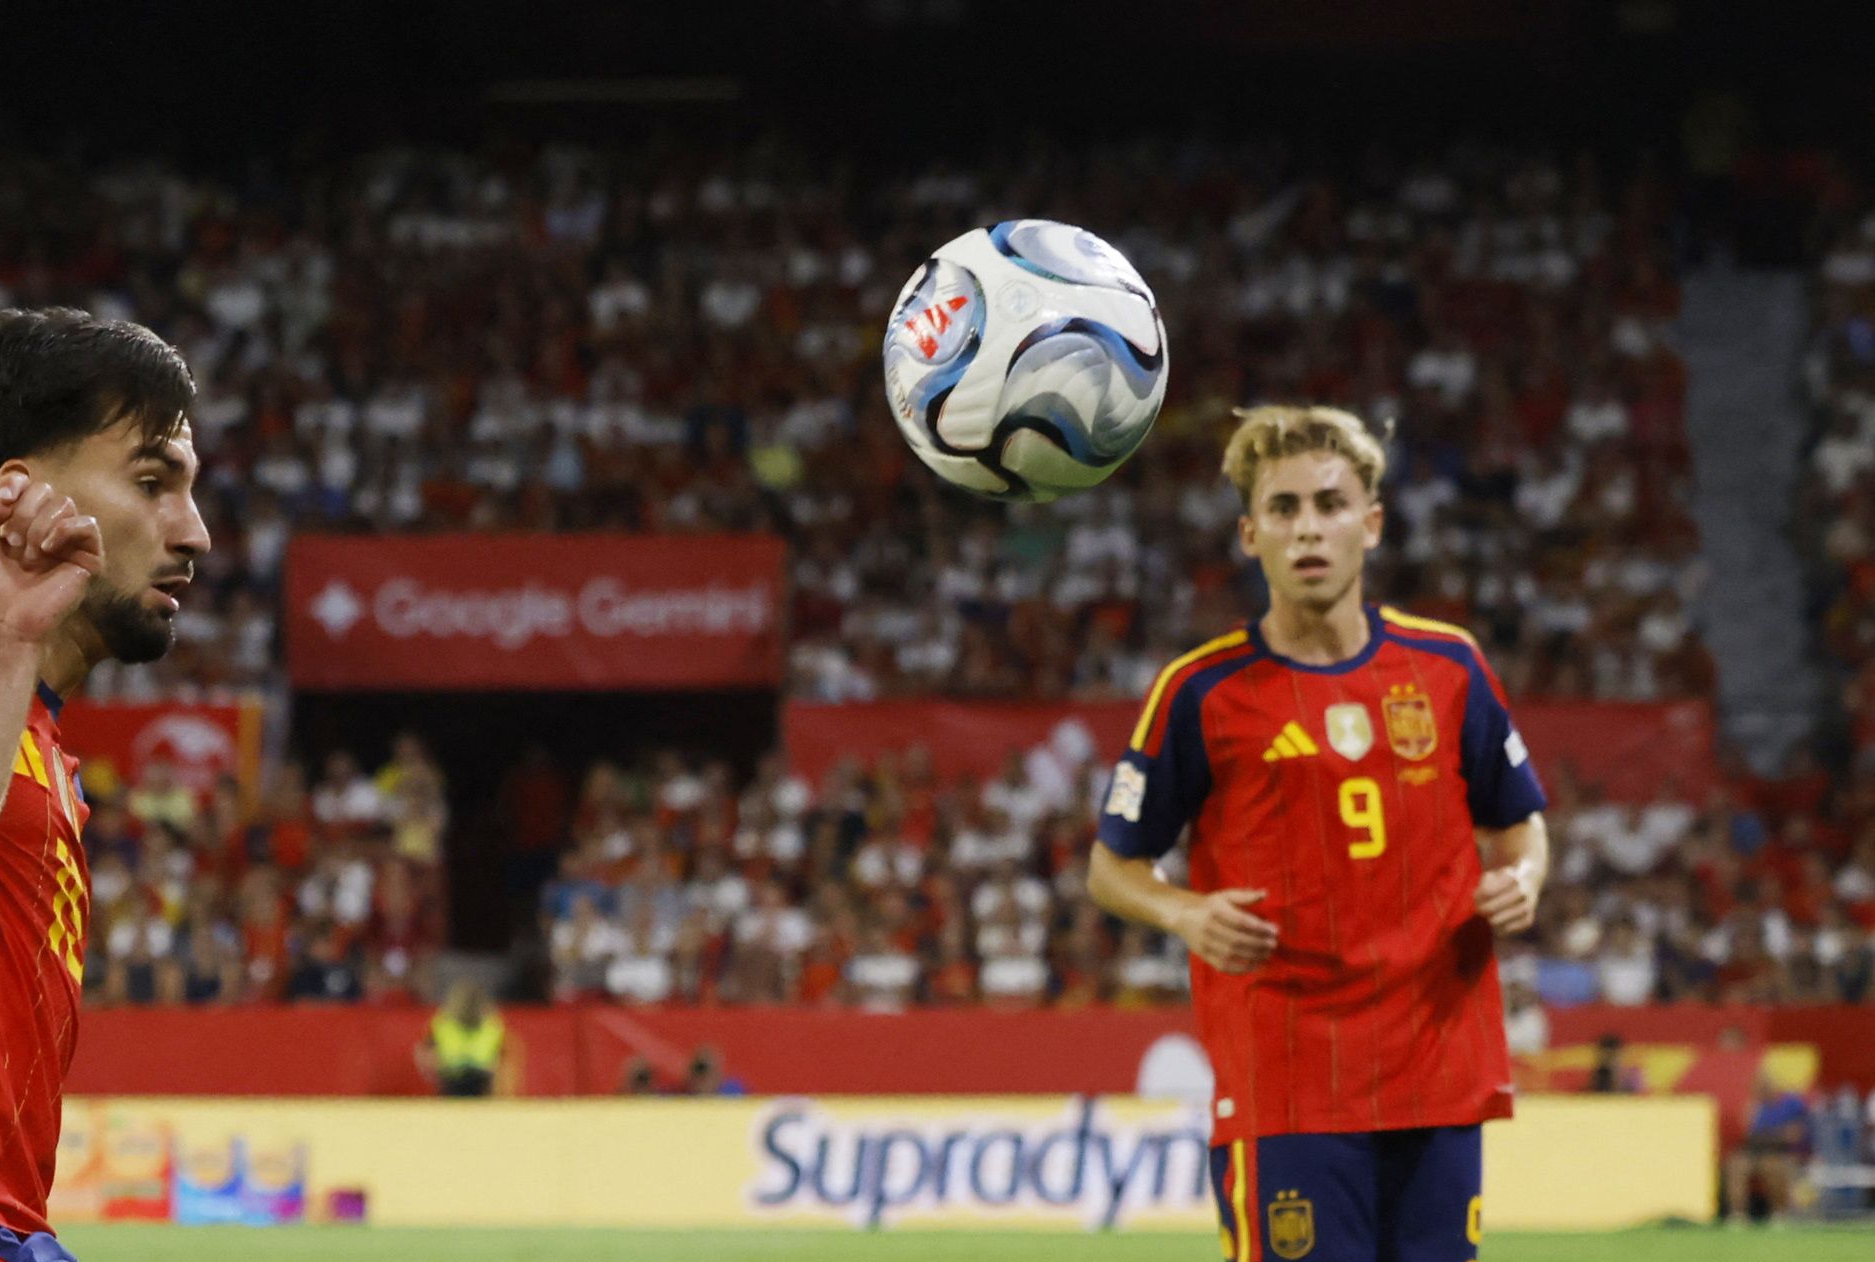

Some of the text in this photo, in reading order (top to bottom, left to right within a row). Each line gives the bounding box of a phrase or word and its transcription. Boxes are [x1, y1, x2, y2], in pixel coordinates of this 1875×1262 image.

[372, 577, 766, 650] Google Gemini
[1337, 776, 1387, 860] 9
[757, 1096, 1216, 1231] Supradyn
